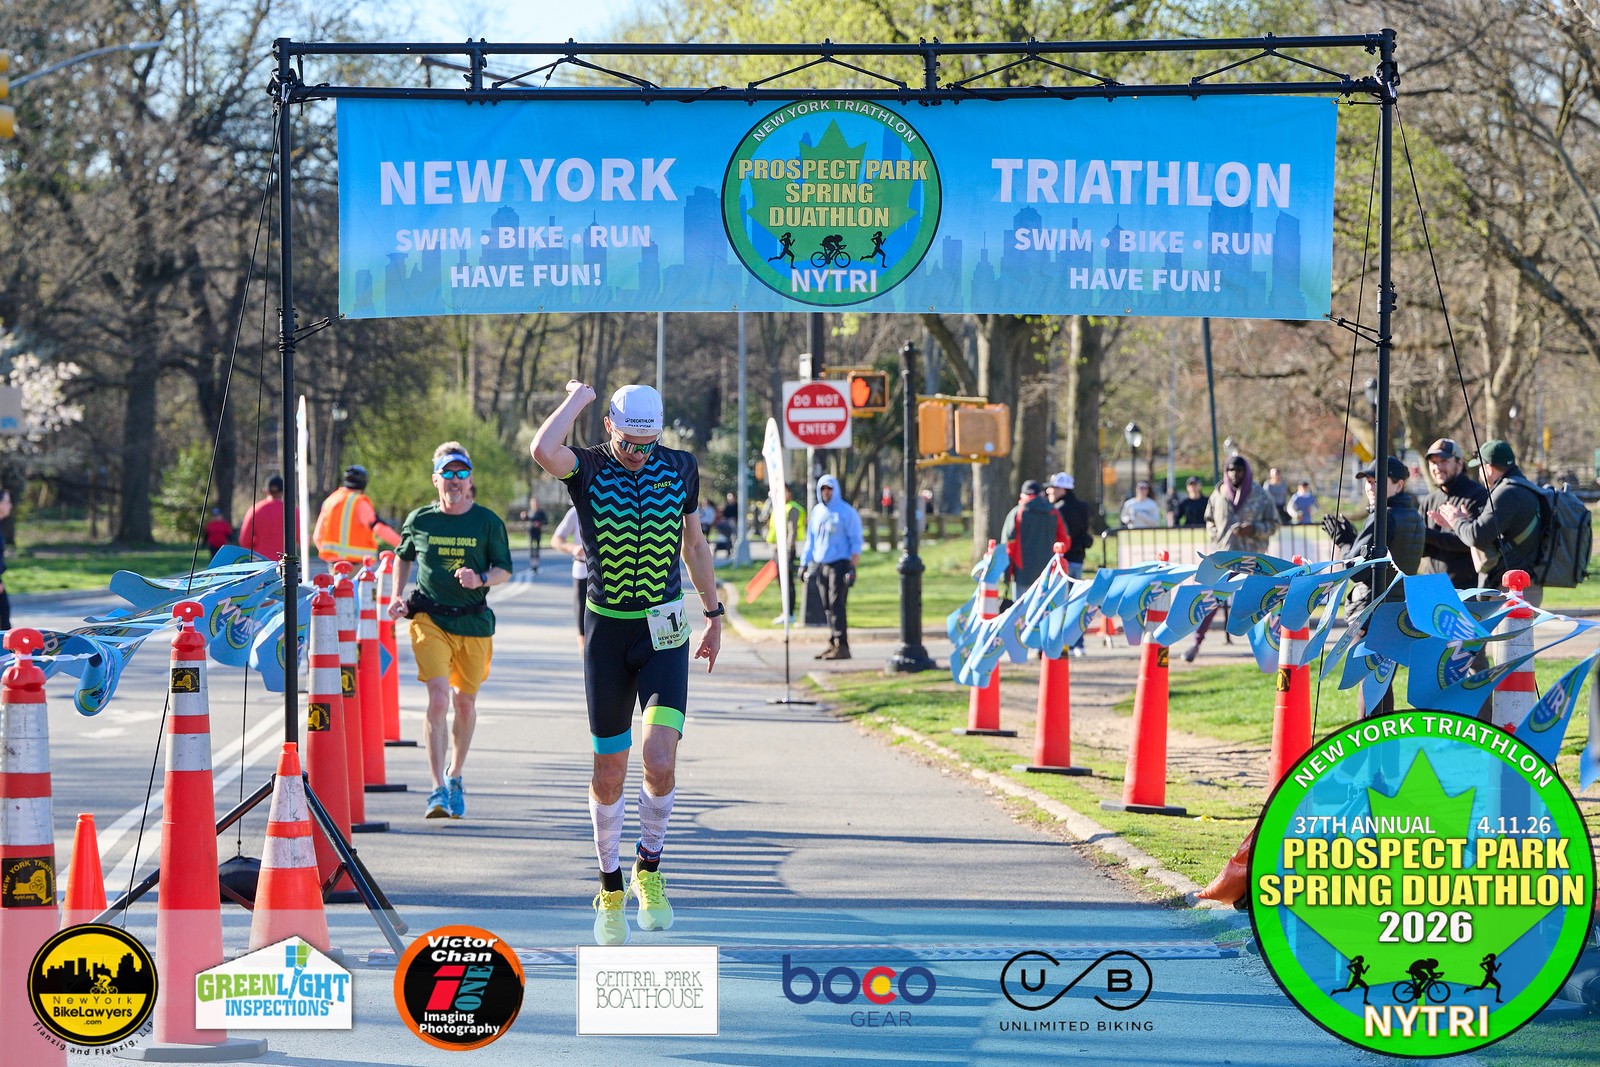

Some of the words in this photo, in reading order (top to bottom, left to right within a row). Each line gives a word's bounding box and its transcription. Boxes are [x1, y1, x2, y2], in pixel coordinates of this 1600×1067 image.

[752, 115, 785, 142] NEW
[787, 100, 830, 118] YORK
[834, 100, 917, 143] TRIATHLON
[380, 159, 507, 206] NEW
[519, 157, 678, 203] YORK
[738, 159, 861, 180] PROSPECT
[865, 159, 928, 180] PARK
[785, 182, 874, 204] SPRING
[991, 158, 1291, 209] TRIATHLON
[769, 206, 890, 228] DUATHLON
[395, 226, 471, 252] SWIM
[499, 226, 564, 249] BIKE
[590, 225, 651, 248] RUN
[1014, 227, 1092, 252] SWIM
[1119, 230, 1185, 253] BIKE
[1211, 231, 1273, 256] RUN
[451, 265, 525, 288] HAVE
[533, 263, 602, 287] FUN!
[791, 269, 877, 293] NYTRI
[1070, 267, 1143, 291] HAVE
[1153, 269, 1221, 293] FUN!
[793, 394, 811, 407] DO
[816, 393, 839, 407] NOT
[798, 423, 837, 436] ENTER
[428, 535, 456, 546] RUNNING
[456, 537, 477, 548] SOULS
[438, 547, 450, 556] RUN
[451, 547, 465, 556] CLUB
[2, 875, 11, 895] NEW
[9, 860, 31, 874] YORK
